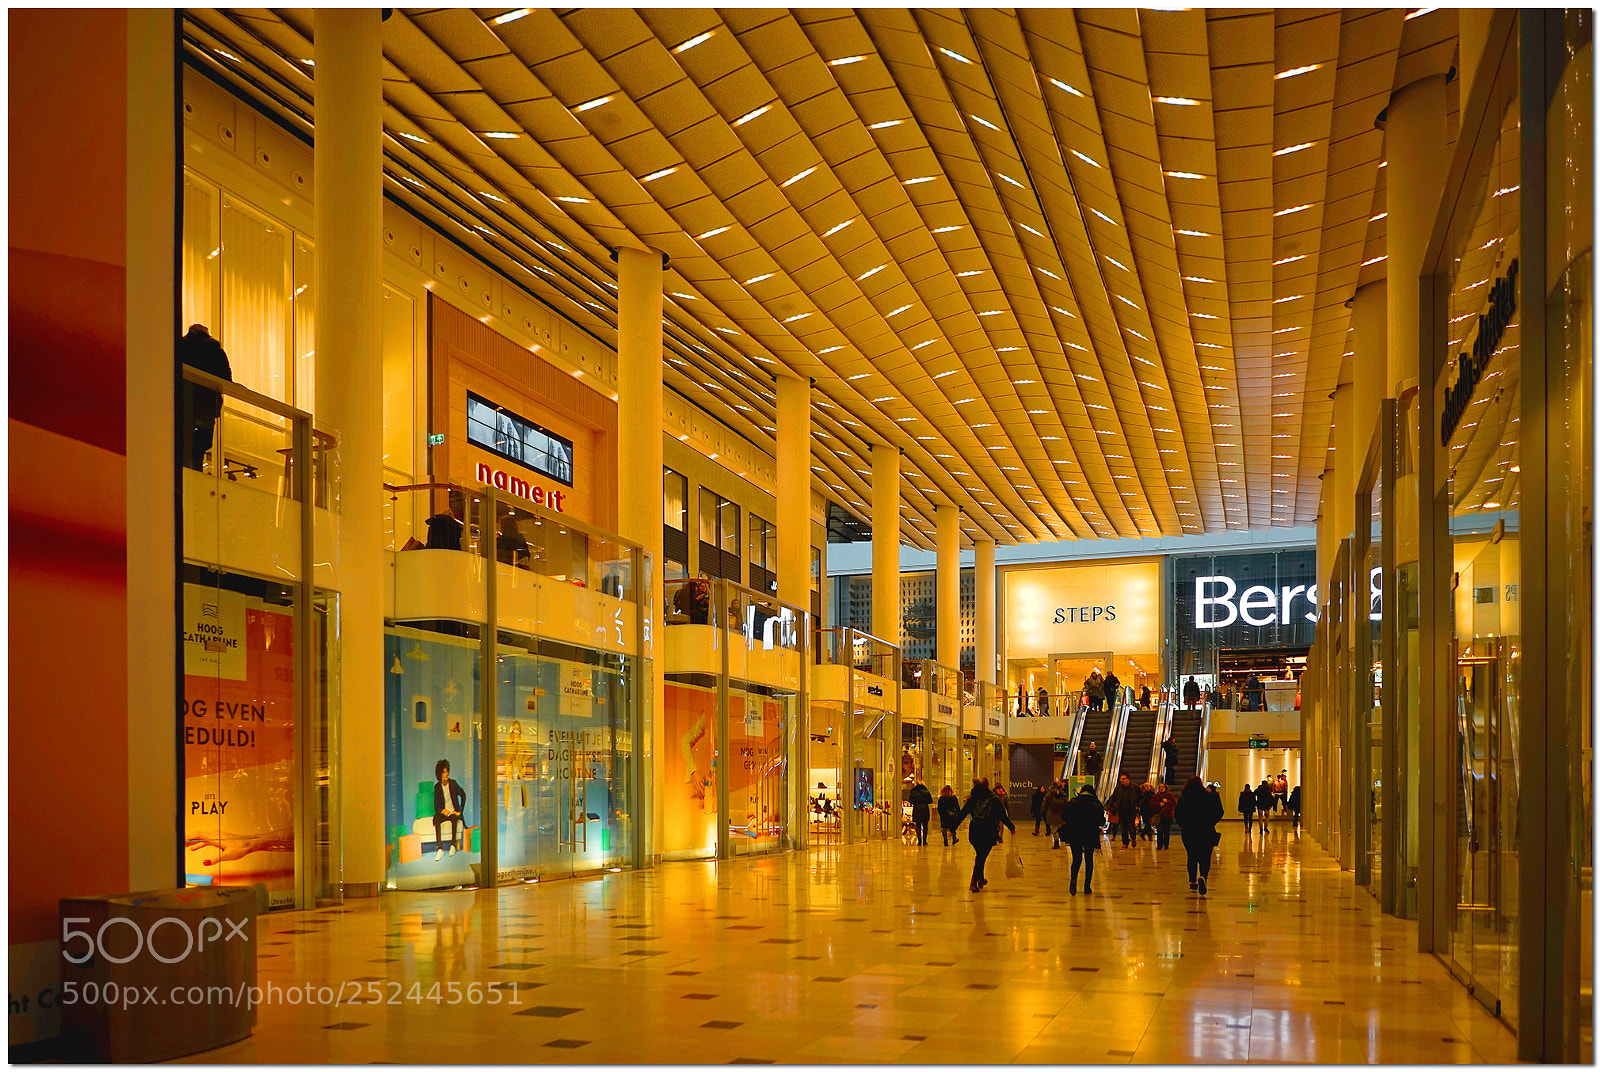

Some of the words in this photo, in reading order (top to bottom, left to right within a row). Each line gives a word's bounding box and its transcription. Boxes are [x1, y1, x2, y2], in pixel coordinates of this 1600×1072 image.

[1053, 605, 1116, 624] STEPS
[197, 623, 224, 636] HOOG
[216, 702, 265, 722] EVEN
[191, 801, 229, 815] PLAY
